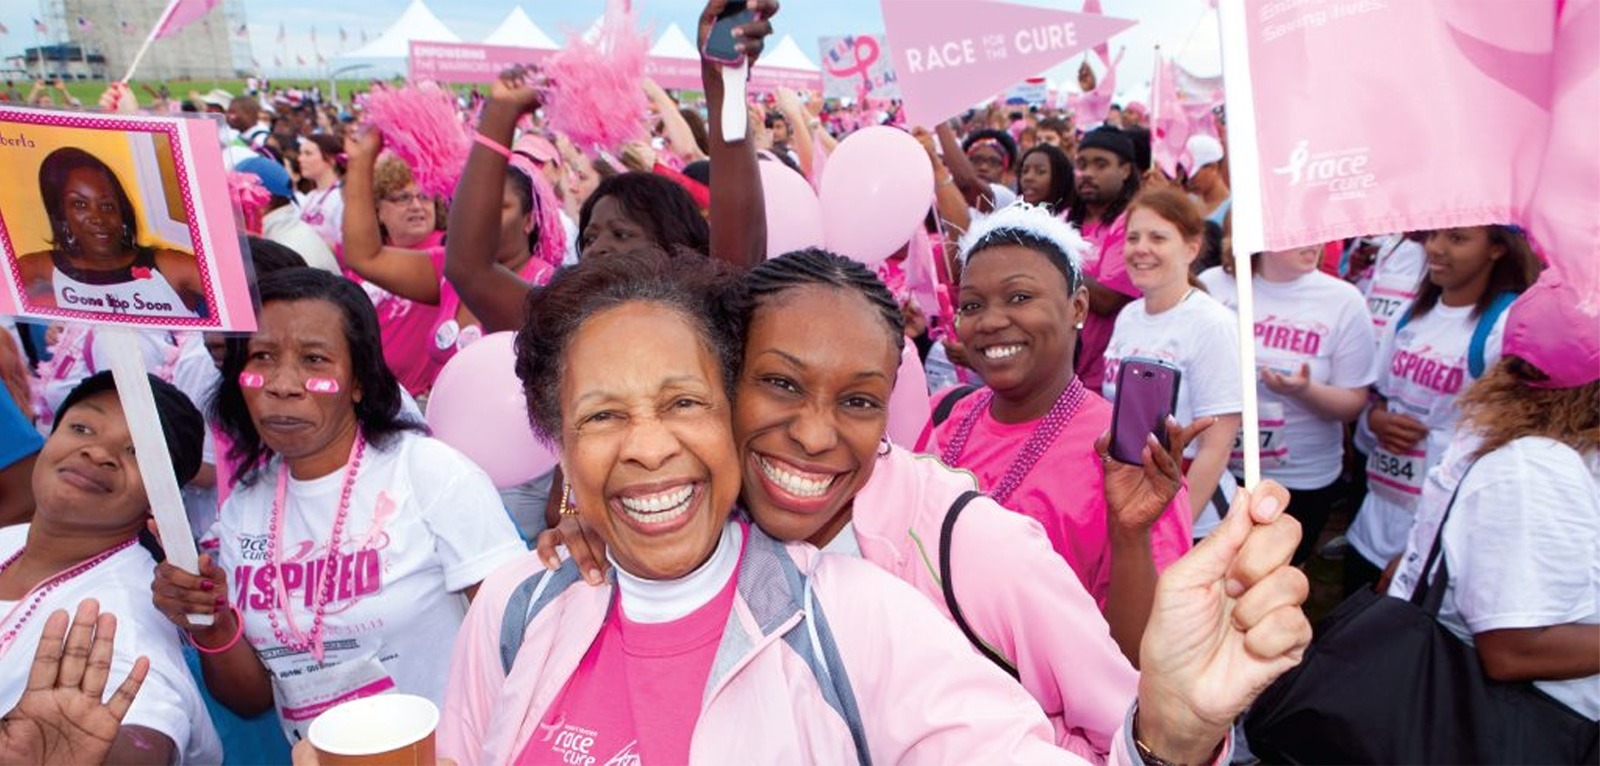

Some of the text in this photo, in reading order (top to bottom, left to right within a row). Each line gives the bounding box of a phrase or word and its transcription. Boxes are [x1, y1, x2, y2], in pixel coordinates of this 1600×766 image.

[413, 46, 487, 60] EMPOWERING
[905, 22, 1077, 73] RACE FOR THE CURE
[1307, 154, 1368, 181] race
[1328, 173, 1376, 191] cure
[61, 286, 104, 307] Gone
[133, 292, 173, 311] Soon
[1391, 349, 1464, 395] SPIRED
[554, 730, 594, 754] race
[563, 749, 596, 766] cure
